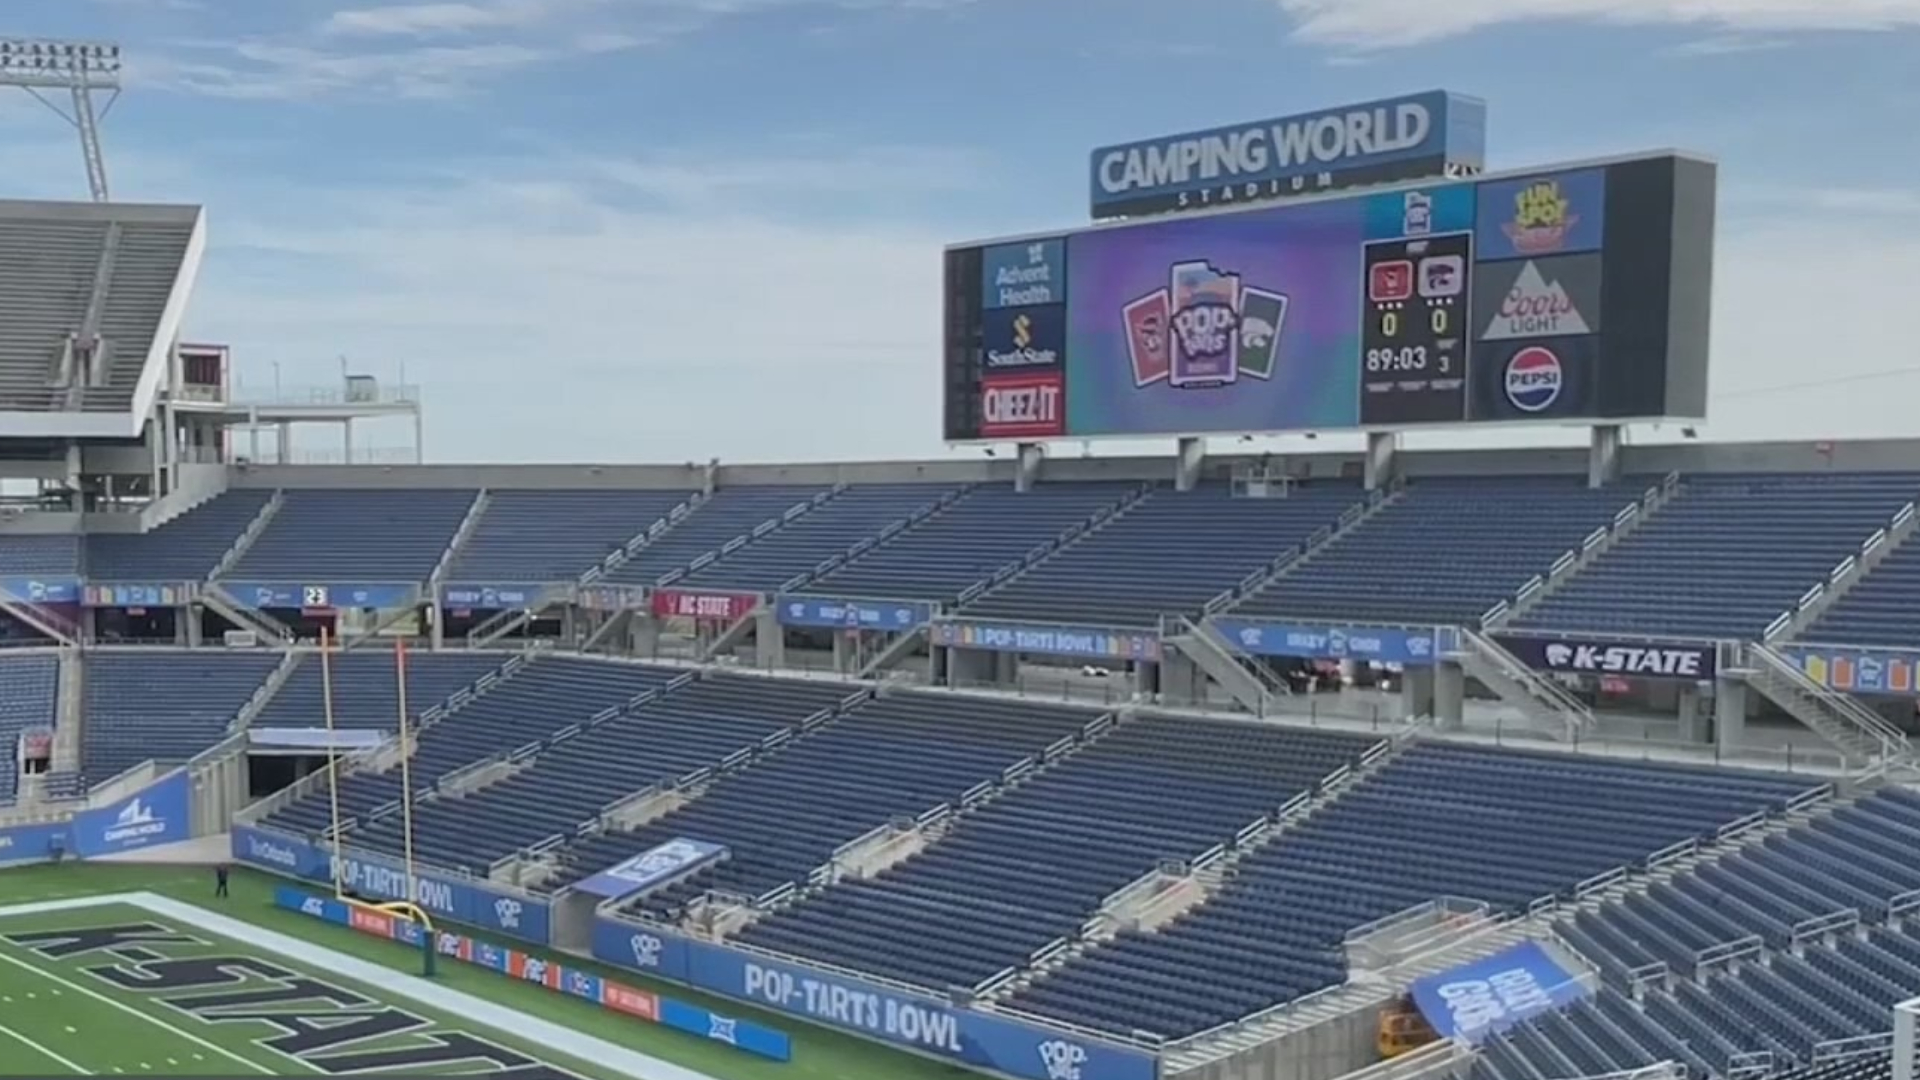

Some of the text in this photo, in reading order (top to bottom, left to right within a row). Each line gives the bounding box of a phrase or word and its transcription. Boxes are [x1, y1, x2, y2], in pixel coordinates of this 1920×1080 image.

[1100, 103, 1430, 193] CAMPING WORLD
[1178, 172, 1334, 207] STADIUM
[995, 263, 1049, 286] Advent
[1000, 285, 1050, 307] Health
[1500, 287, 1574, 319] Coors
[1381, 308, 1447, 337] 0 0
[1510, 316, 1559, 334] LIGHT
[1366, 346, 1426, 371] 89:03
[1438, 356, 1450, 373] 3
[1509, 371, 1558, 386] PEPSI
[983, 385, 1059, 423] CHEEZ-IT
[697, 595, 732, 617] STATE
[1572, 645, 1701, 675] K-STATE
[0, 921, 592, 1080] K-STAT
[744, 963, 963, 1052] POP-TARTS BOWL
